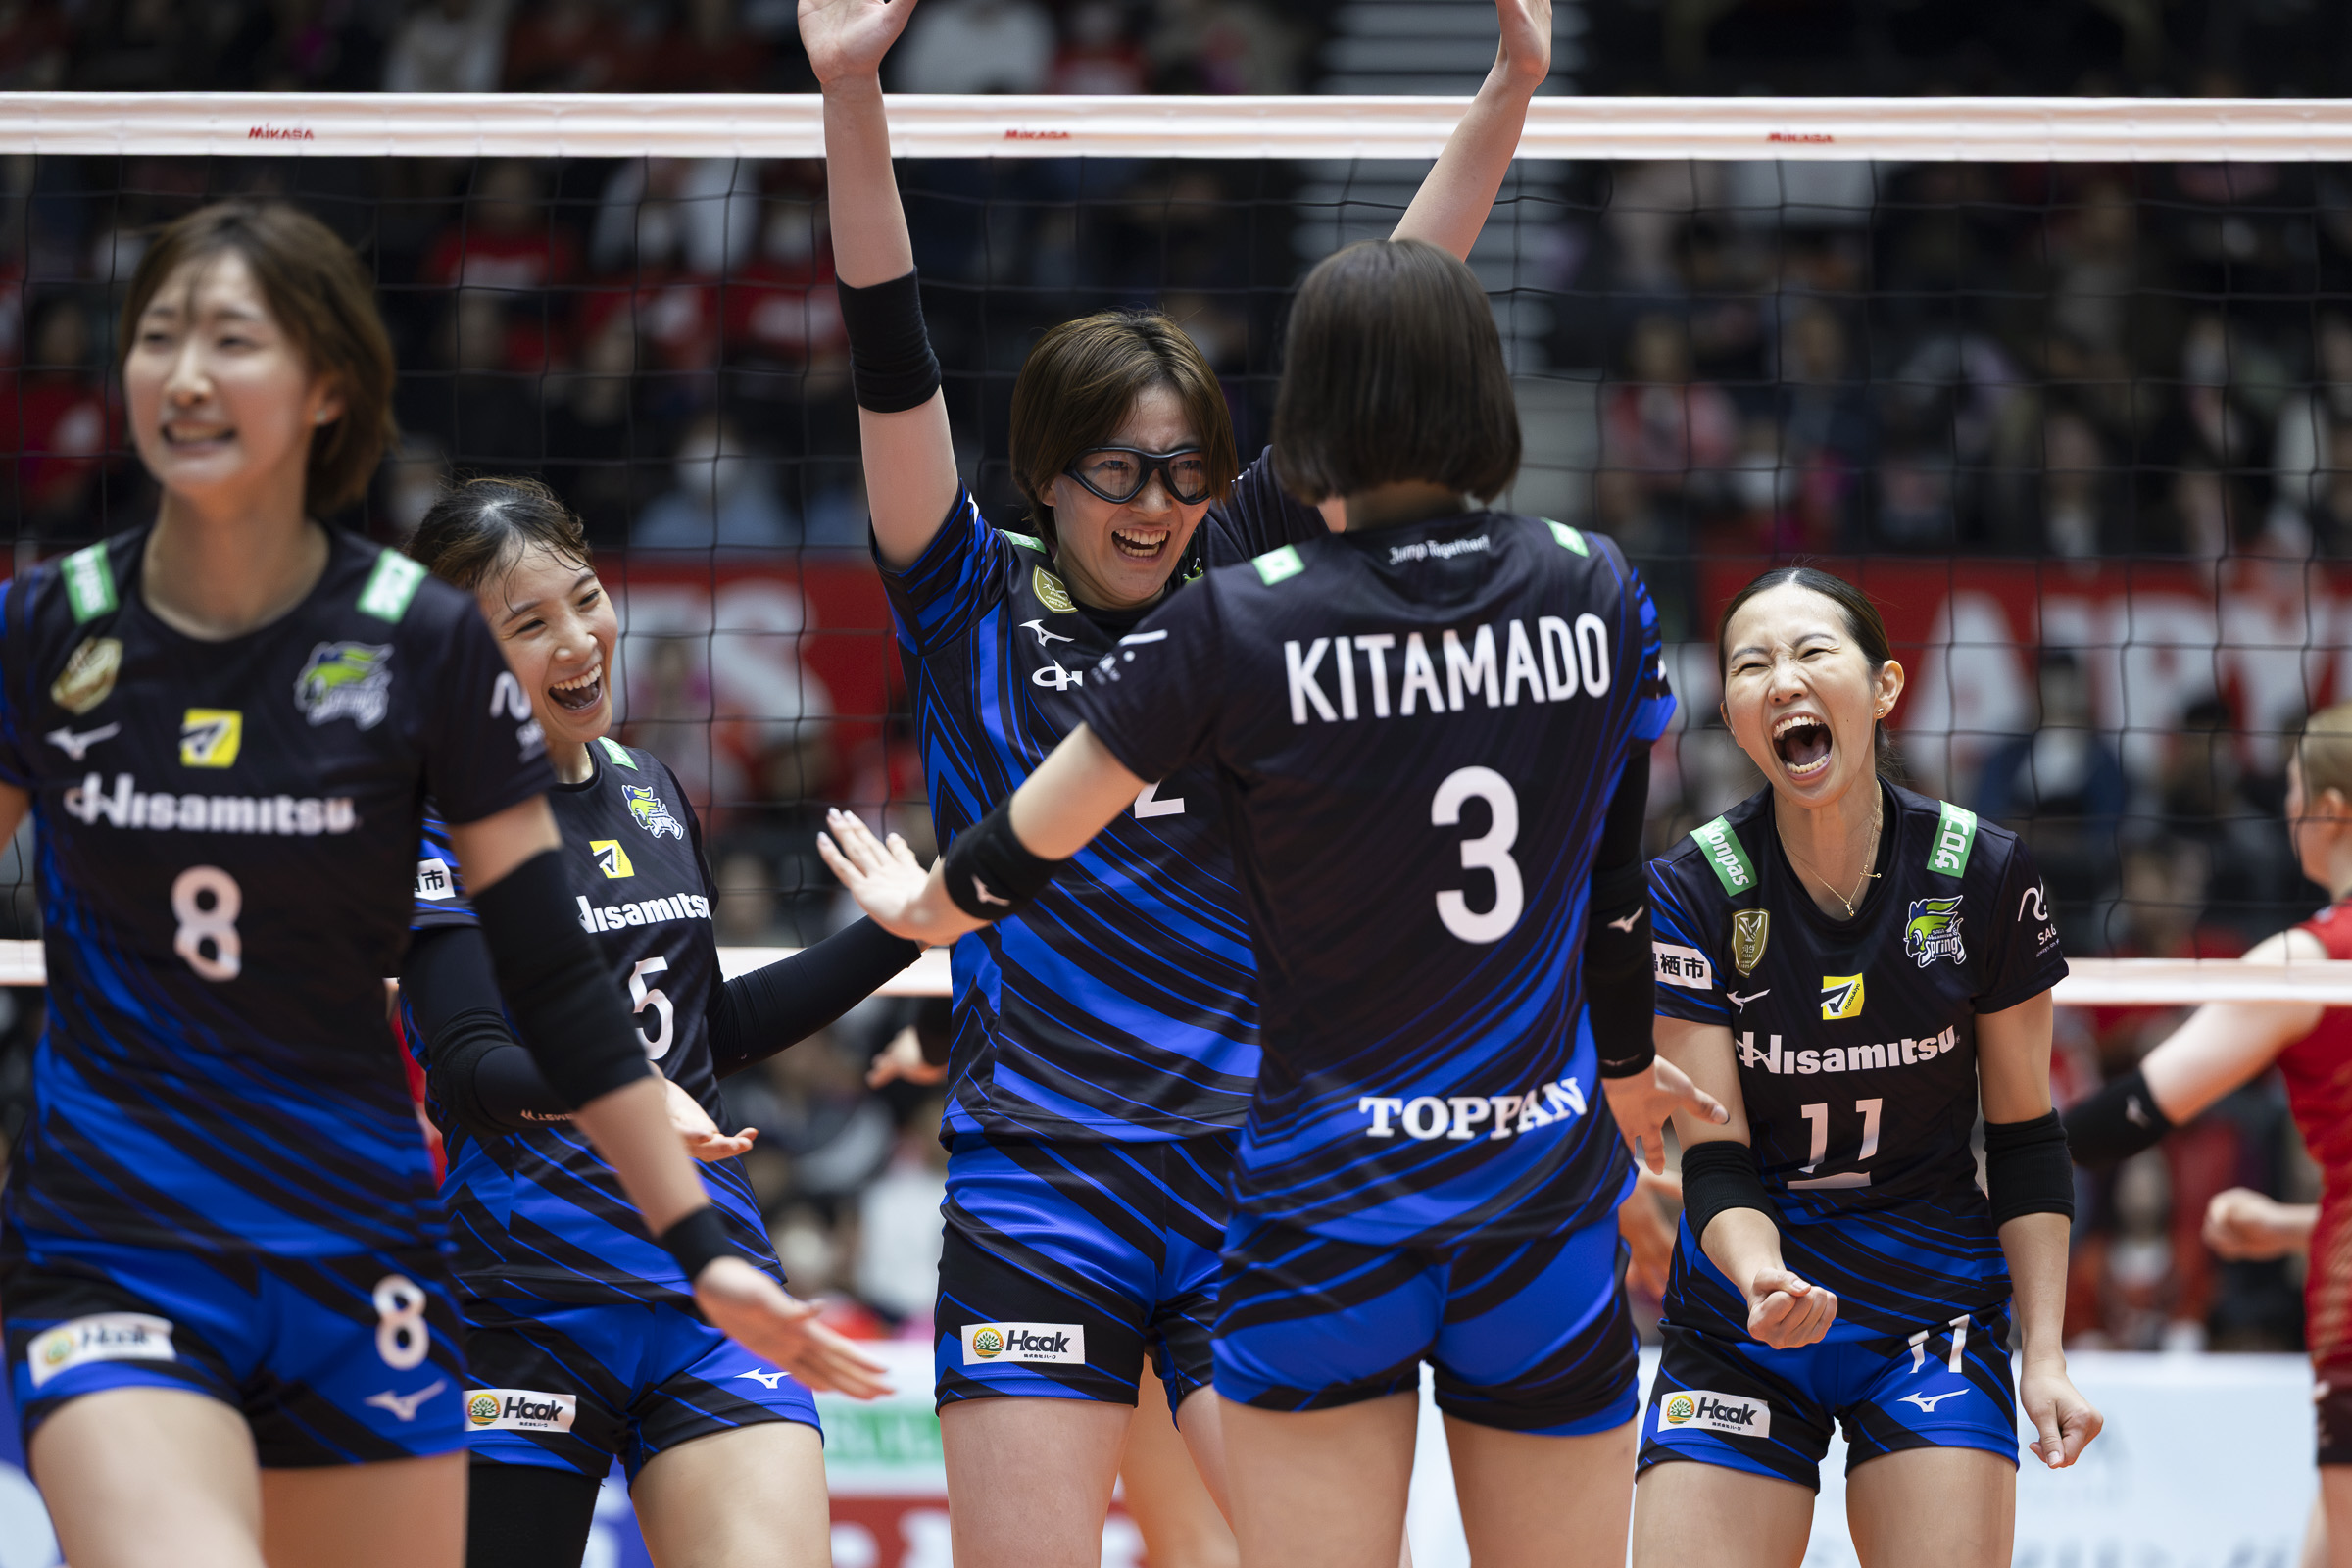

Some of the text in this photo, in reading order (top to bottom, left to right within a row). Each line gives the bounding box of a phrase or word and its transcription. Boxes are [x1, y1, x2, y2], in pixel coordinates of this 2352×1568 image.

[1389, 543, 1428, 565] Jump
[1285, 612, 1610, 724] KITAMADO
[63, 773, 357, 835] Hisamitsu
[1431, 765, 1524, 944] 3
[171, 865, 242, 981] 8
[628, 956, 673, 1060] 5
[1735, 1025, 1955, 1075] Hisamitsu
[1358, 1077, 1587, 1140] TOPPAN
[1787, 1097, 1883, 1190] 11
[372, 1275, 429, 1369] 8
[1005, 1329, 1071, 1353] Haak
[503, 1396, 564, 1421] Haak
[1696, 1396, 1757, 1426] Haak
